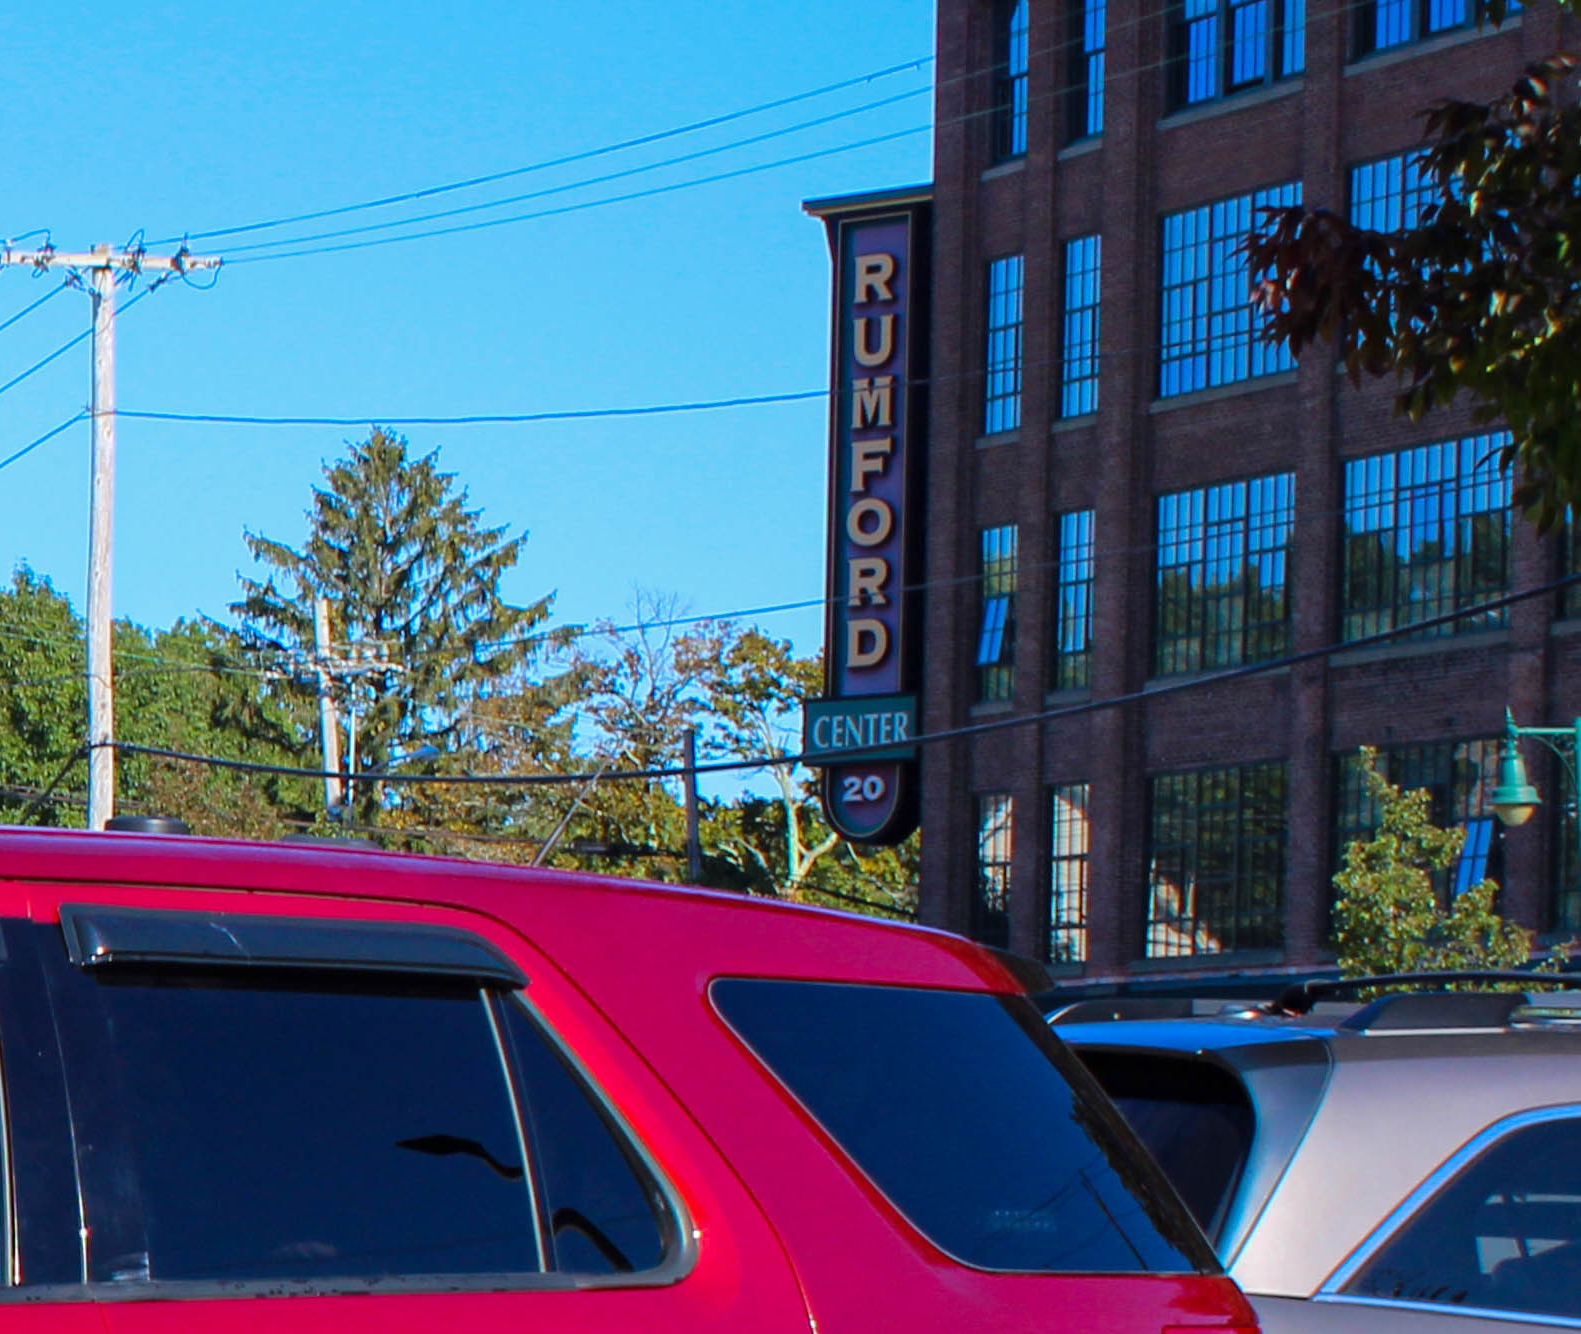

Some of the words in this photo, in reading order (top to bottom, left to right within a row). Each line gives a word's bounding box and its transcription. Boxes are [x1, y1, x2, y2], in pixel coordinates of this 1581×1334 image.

[845, 252, 896, 669] RUMFORD
[813, 711, 909, 749] CENTER
[842, 775, 886, 802] 20
